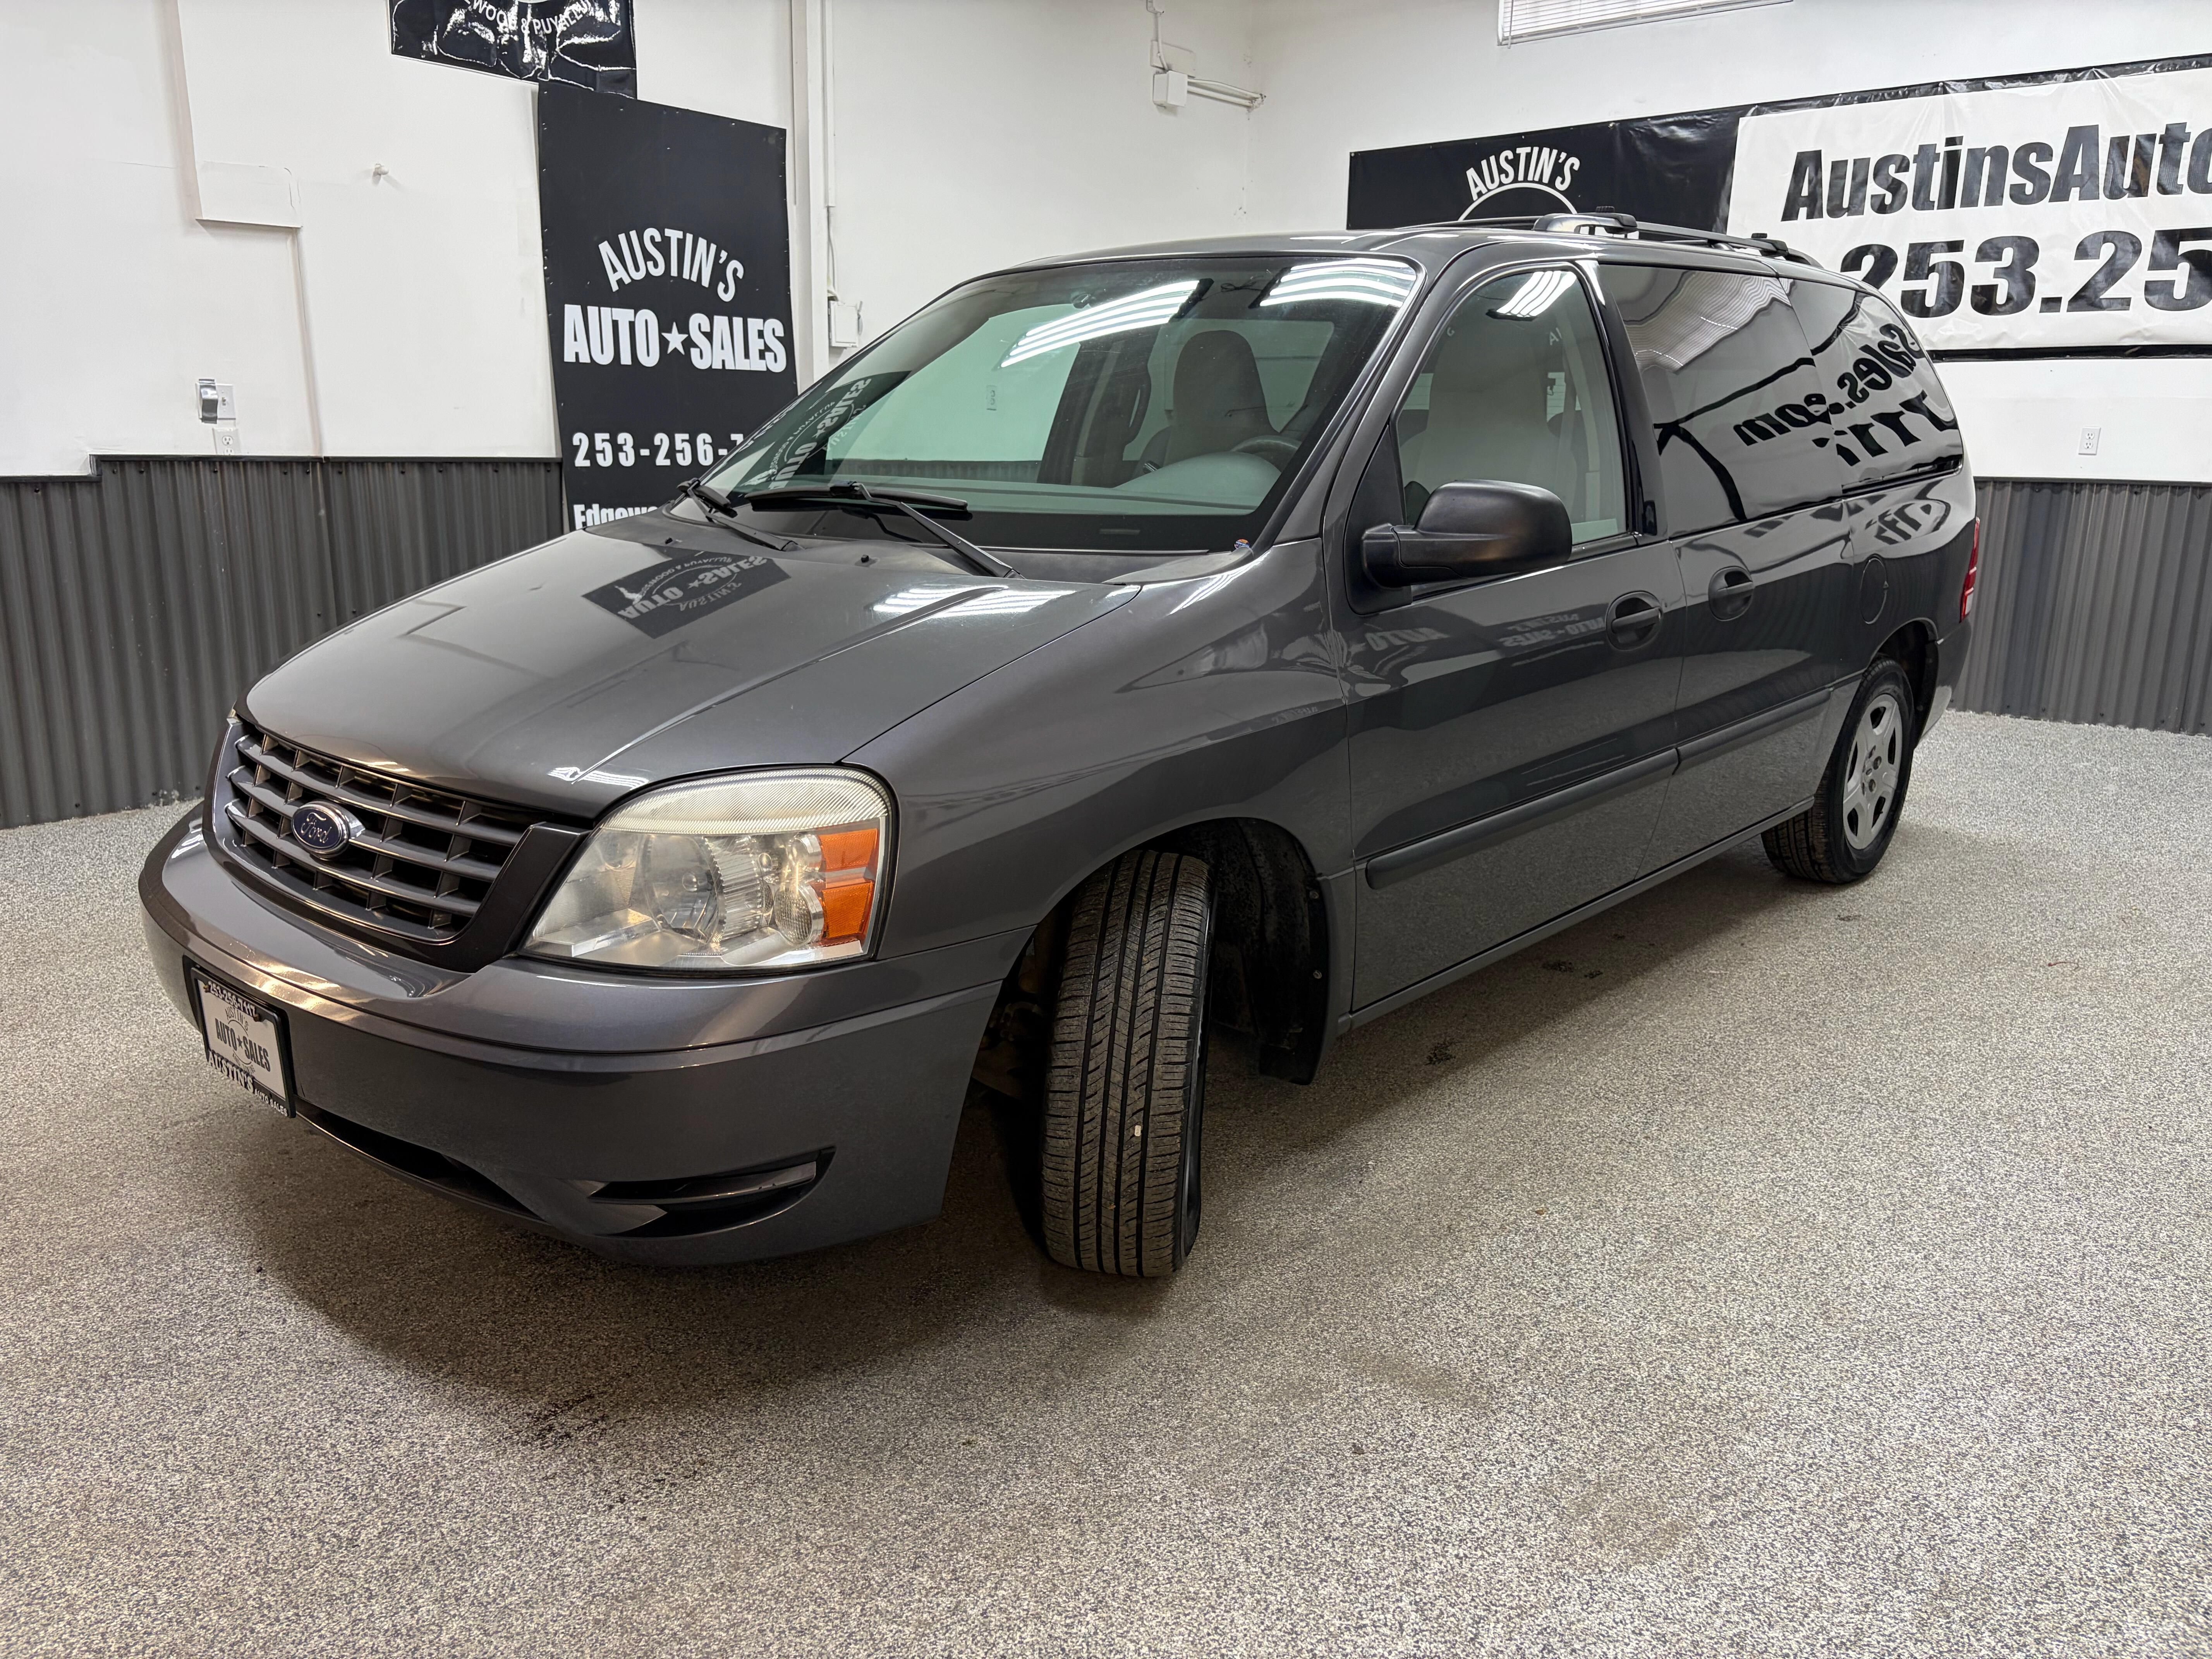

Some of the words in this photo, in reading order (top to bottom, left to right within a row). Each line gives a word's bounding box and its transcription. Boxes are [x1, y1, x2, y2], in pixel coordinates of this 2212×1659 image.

[1466, 146, 1580, 201] AUSTIN'S
[598, 228, 744, 302] AUSTIN'S
[564, 304, 660, 367] AUTO
[689, 313, 787, 373] SALES
[208, 981, 256, 1017] 253-256-7117
[225, 1006, 249, 1031] AUSTIN'S
[215, 1017, 237, 1051] AUTO
[243, 1036, 271, 1072] SALES
[208, 1050, 254, 1093] AUSTIN'S
[255, 1089, 269, 1104] AUTO
[270, 1099, 288, 1117] SALES
